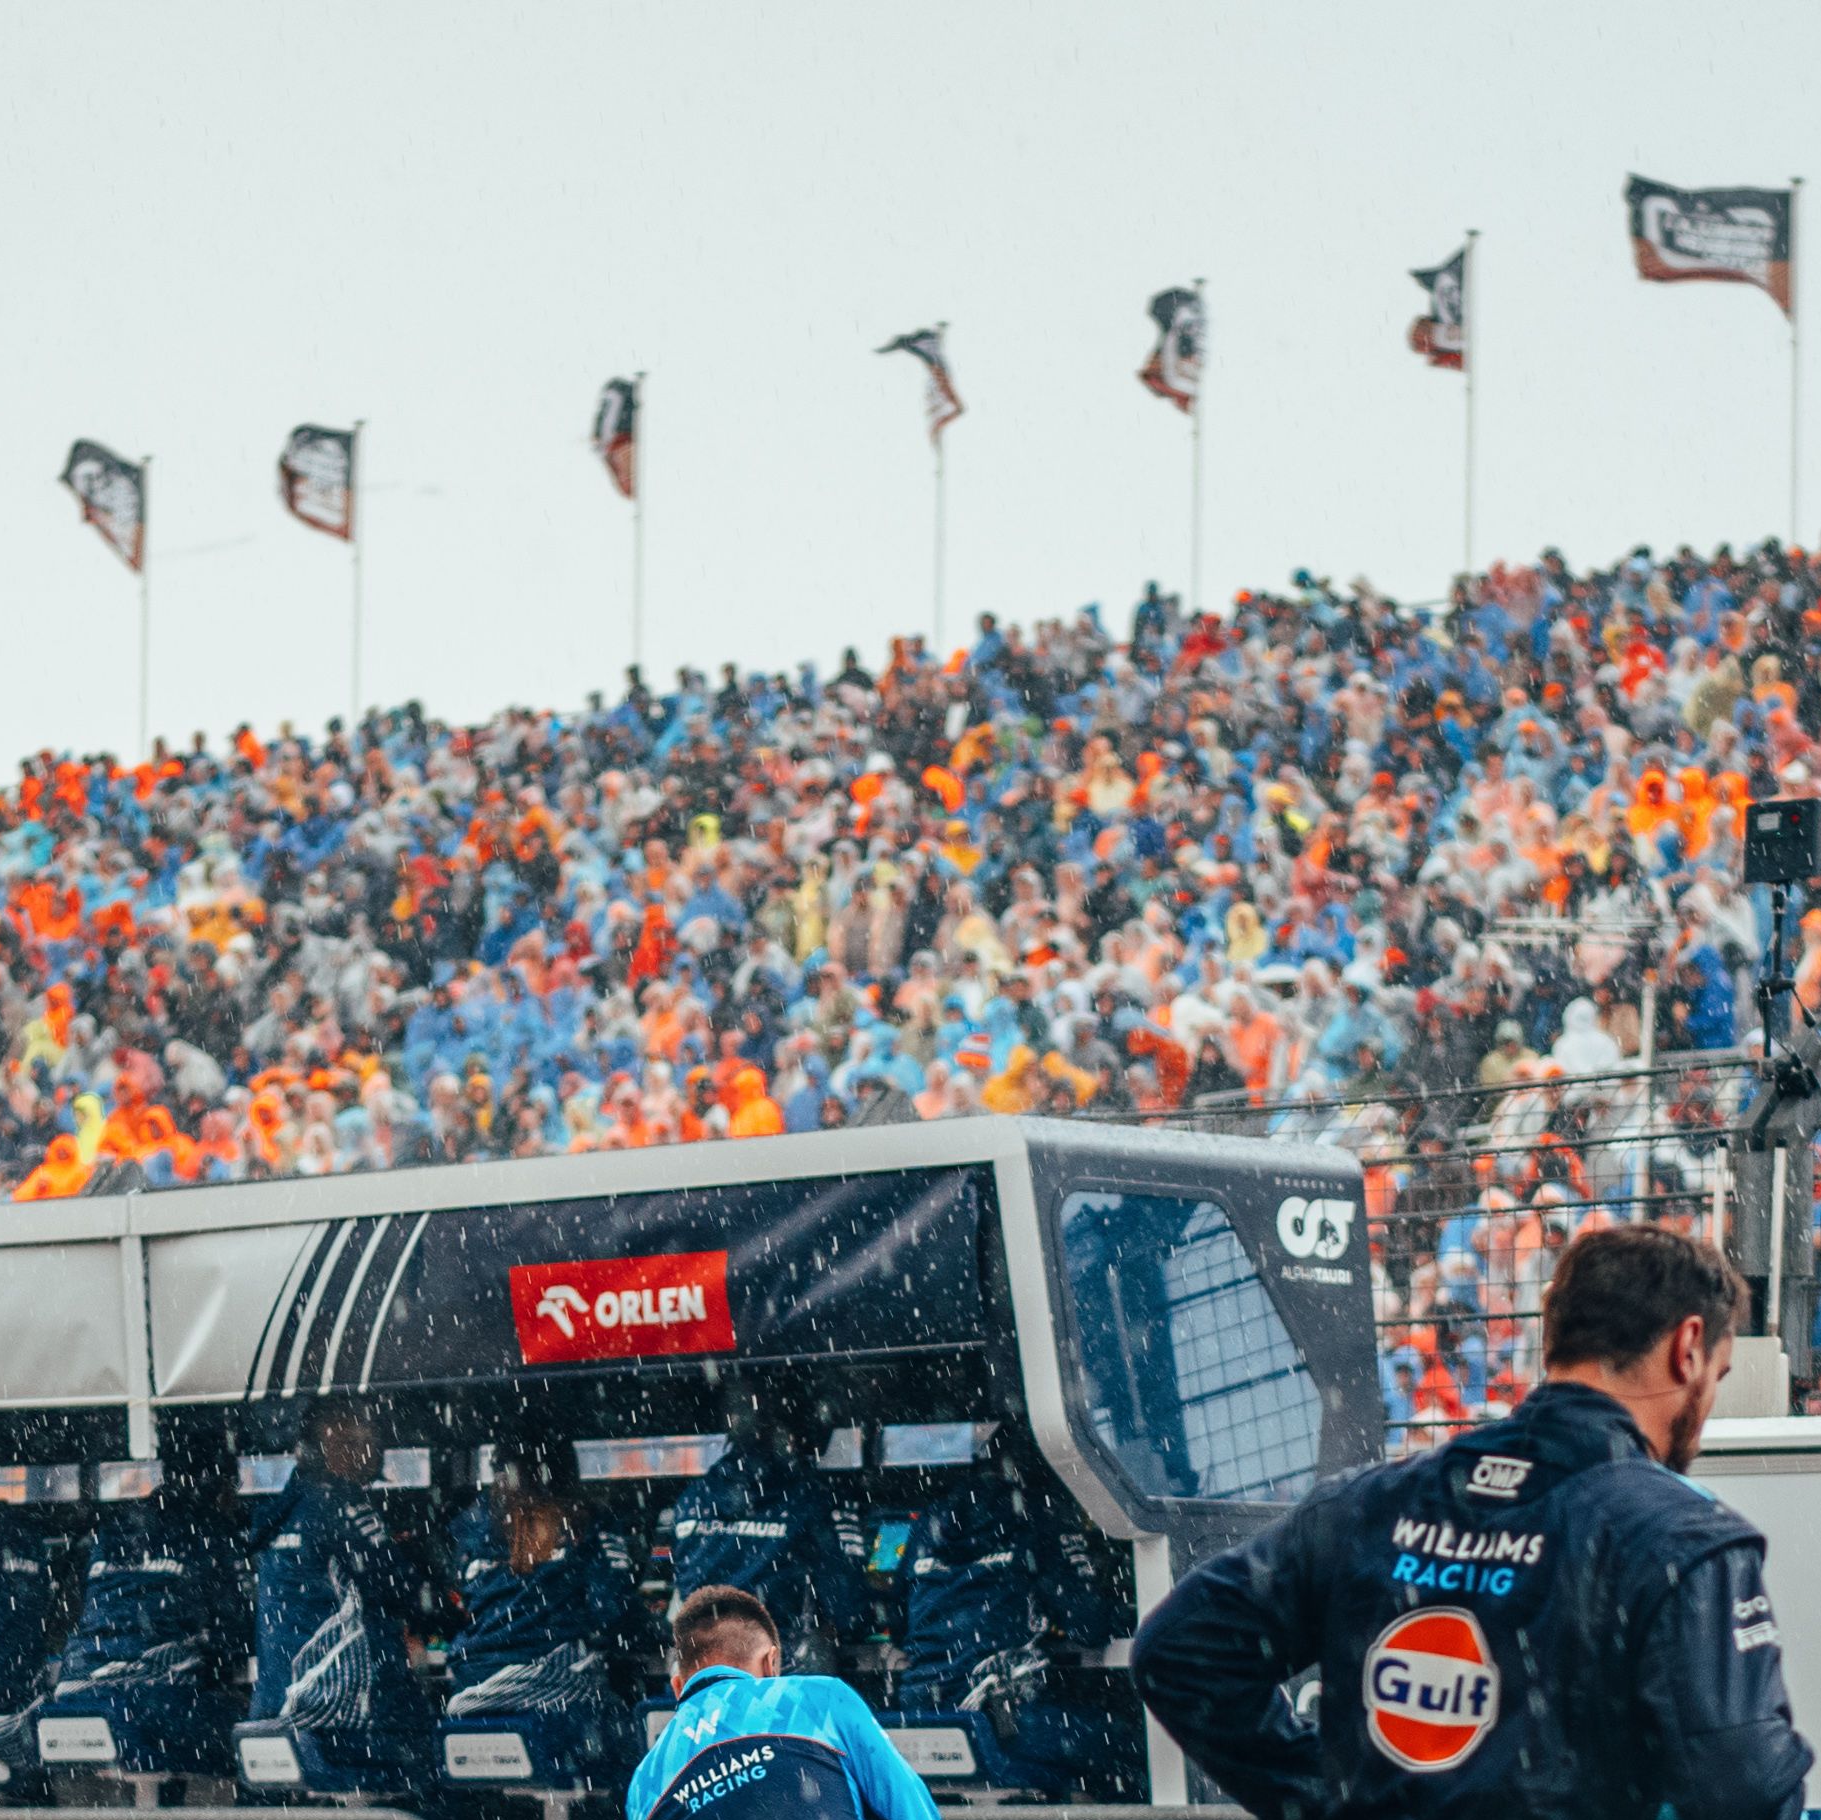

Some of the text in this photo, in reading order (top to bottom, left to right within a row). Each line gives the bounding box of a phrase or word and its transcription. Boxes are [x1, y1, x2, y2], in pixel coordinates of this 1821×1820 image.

[594, 1284, 707, 1329] ORLEN
[1470, 1459, 1530, 1493] OMP
[1372, 1657, 1491, 1717] Gulf
[673, 1744, 776, 1804] WILLIAMS
[688, 1764, 768, 1814] RACING
